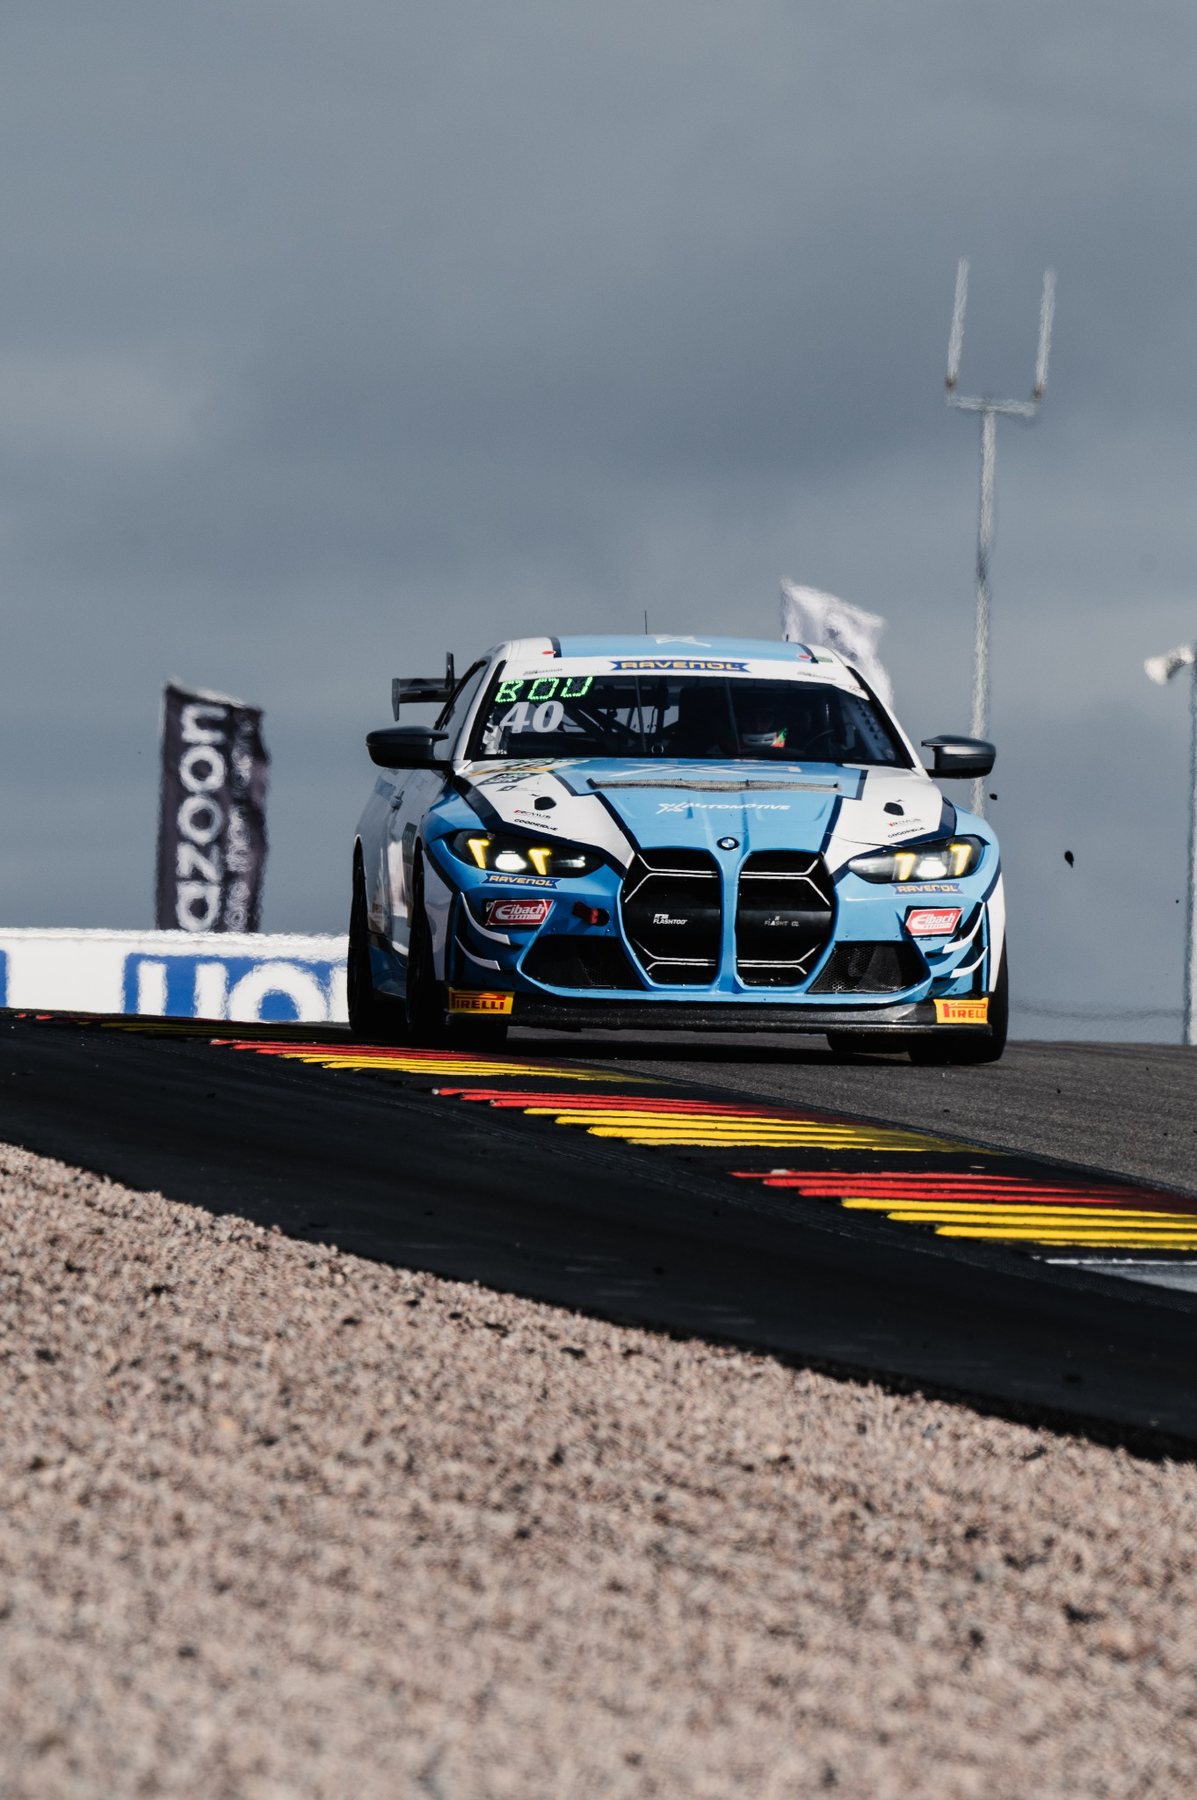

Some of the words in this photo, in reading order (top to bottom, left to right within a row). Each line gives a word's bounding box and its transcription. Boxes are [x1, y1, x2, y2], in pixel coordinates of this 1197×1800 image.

[620, 660, 741, 671] RAVENOL
[500, 700, 564, 734] 40
[489, 875, 553, 886] RAVENOL
[897, 884, 958, 893] RAVENOL
[495, 903, 545, 920] Eibach
[452, 992, 505, 1010] PIRELLI
